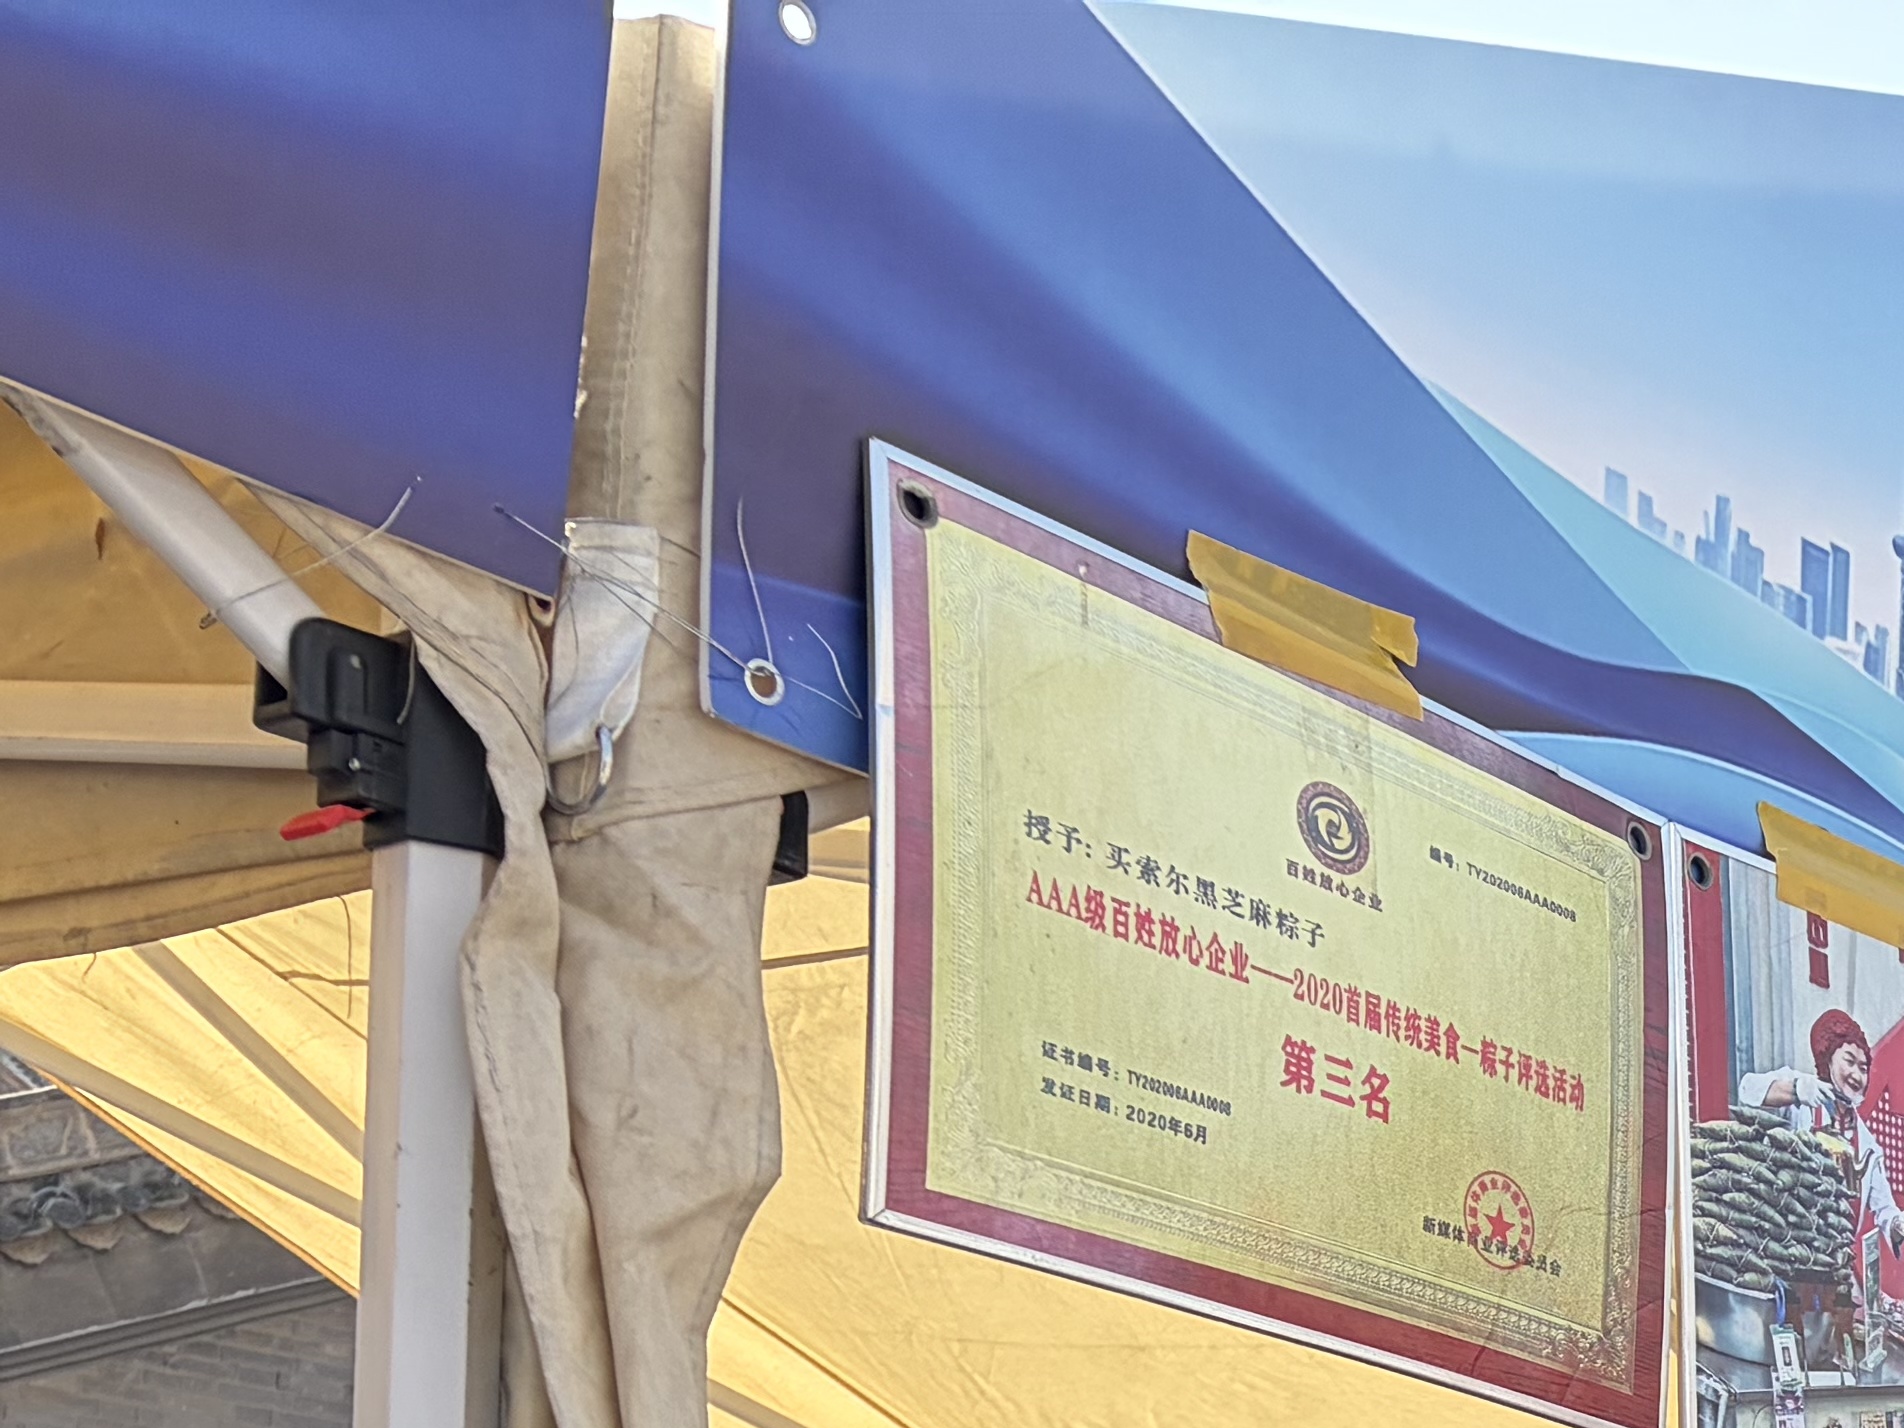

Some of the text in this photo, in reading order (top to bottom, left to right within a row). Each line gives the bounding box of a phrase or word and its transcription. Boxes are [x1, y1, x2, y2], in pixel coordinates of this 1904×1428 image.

[1286, 858, 1384, 913] 百姓放心企业
[1280, 1034, 1392, 1125] 第三名
